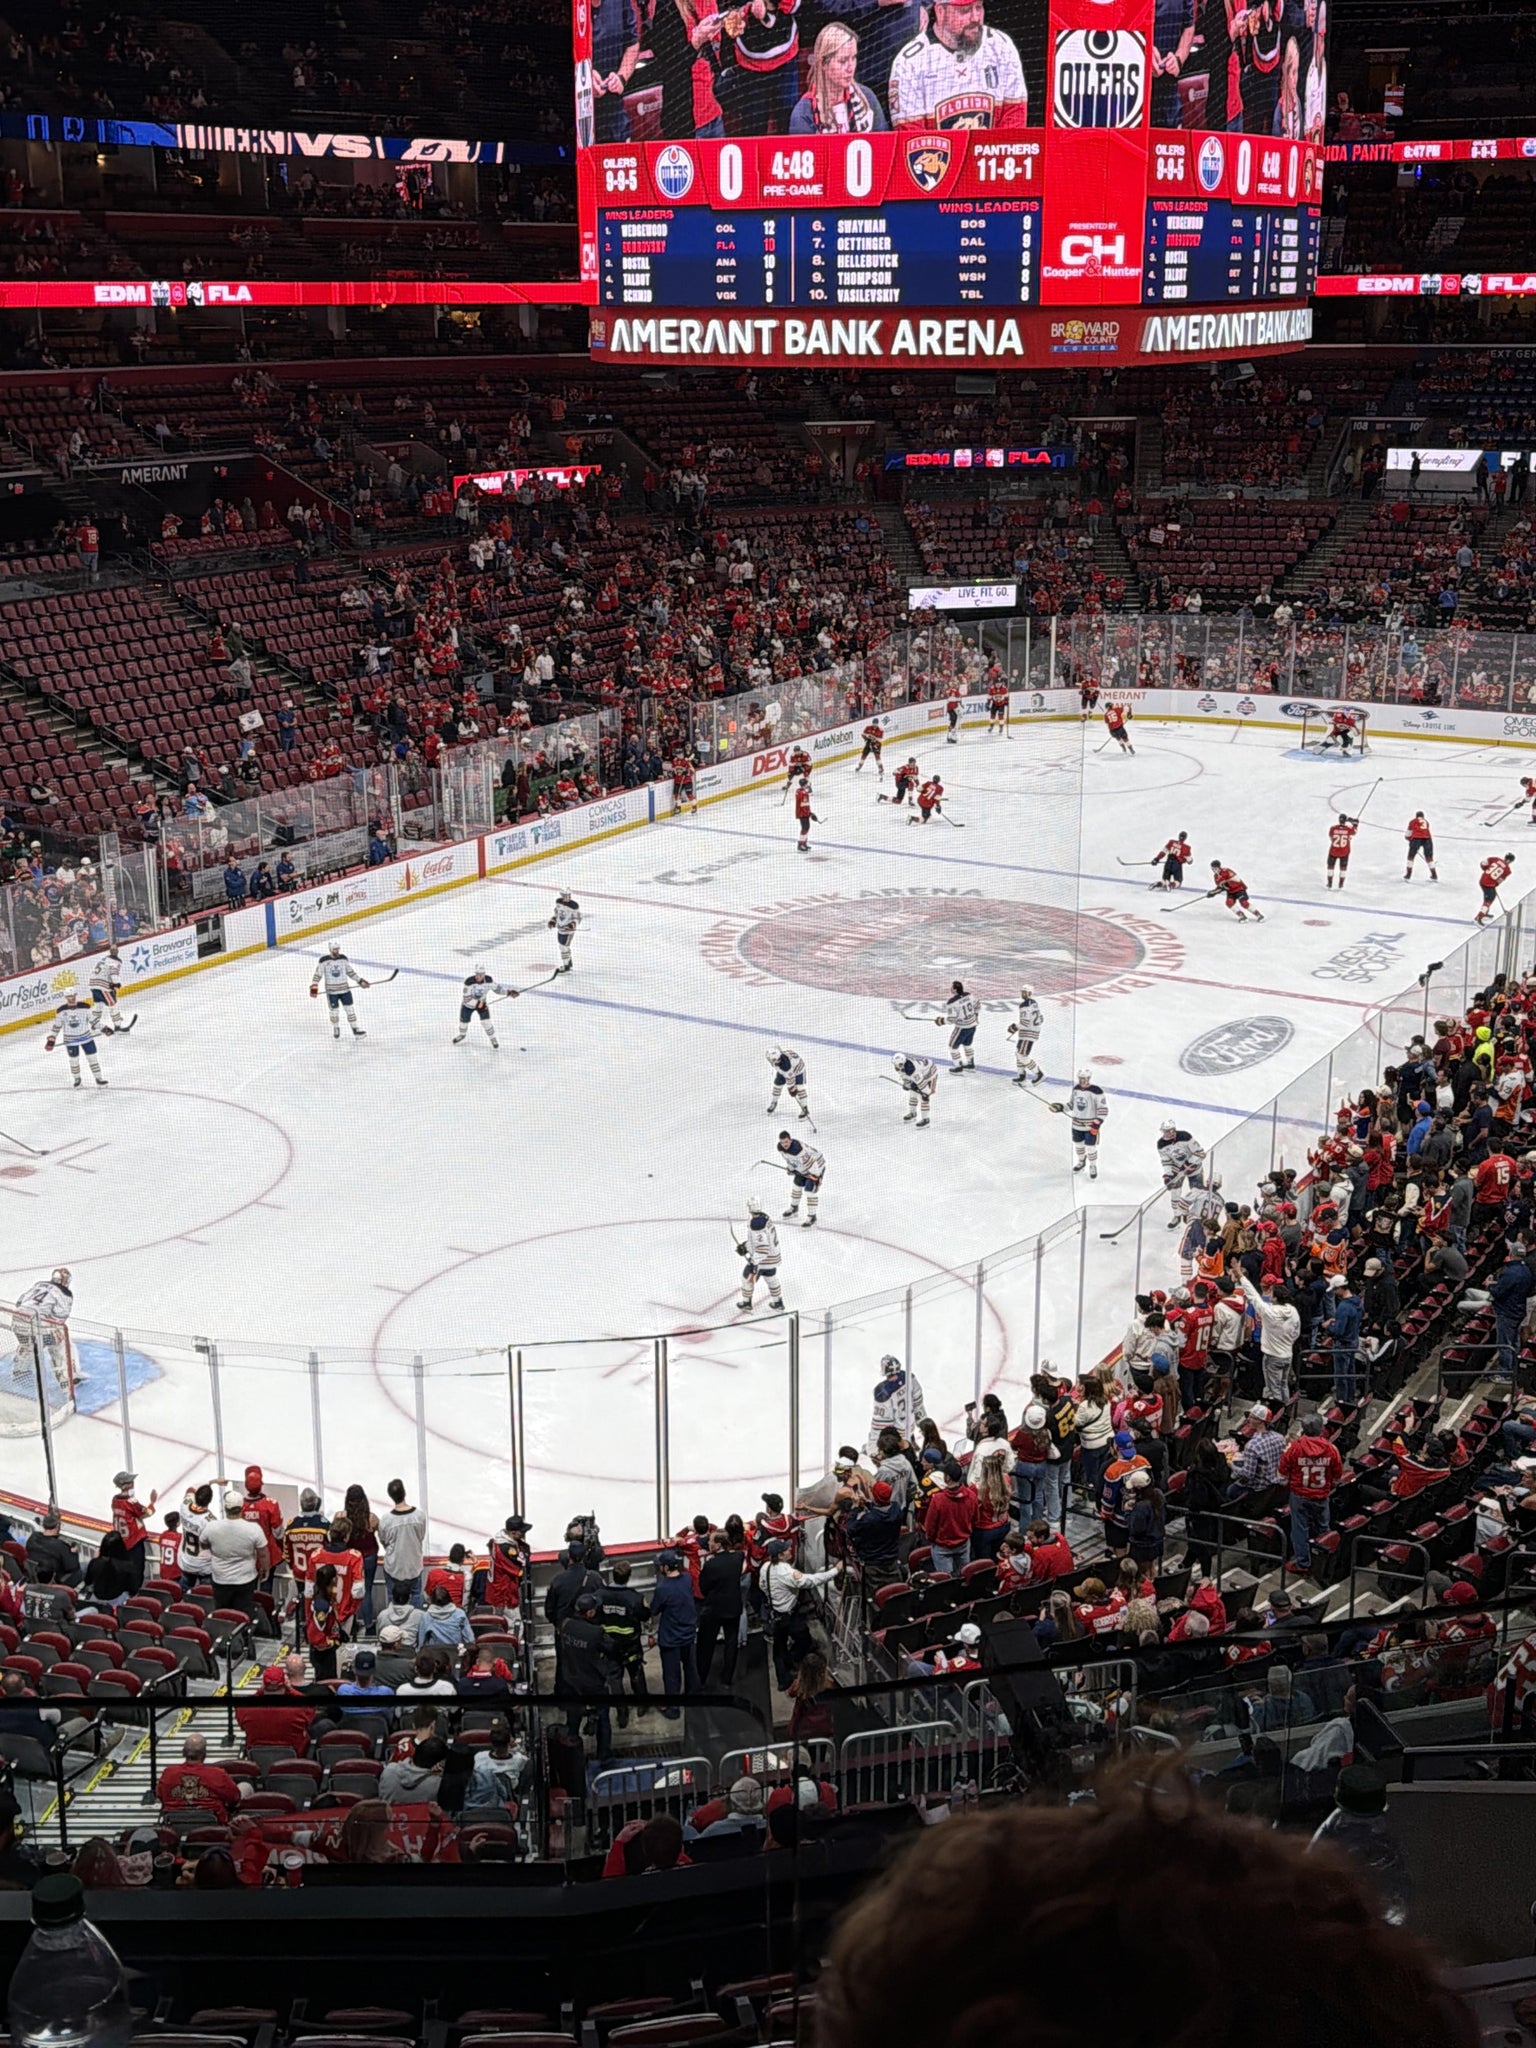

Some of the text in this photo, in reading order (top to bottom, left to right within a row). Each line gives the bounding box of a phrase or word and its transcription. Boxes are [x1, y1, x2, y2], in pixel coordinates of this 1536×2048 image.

[1060, 63, 1141, 95] OILERS
[294, 132, 373, 158] VS
[974, 143, 1040, 156] PANTHERS
[1156, 144, 1185, 156] OILERS
[603, 157, 637, 169] OILERS
[772, 151, 814, 180] 4:48
[846, 139, 872, 197] 0
[977, 158, 1032, 181] 11-8-1
[1237, 140, 1251, 195] 0
[1287, 145, 1298, 198] 0
[719, 144, 743, 200] 0
[606, 170, 637, 192] 9-9-5
[763, 184, 823, 196] PRE-GAME
[629, 209, 674, 220] LEADERS
[939, 201, 1039, 213] WINS LEADERS
[621, 224, 668, 237] WEDGEWOOD
[716, 224, 735, 233] COL
[763, 220, 775, 235] 12
[812, 221, 825, 231] 6.
[837, 219, 886, 233] SWAYMAN
[960, 220, 986, 229] BOS
[716, 242, 735, 250] FLA
[763, 238, 775, 253] 10
[812, 238, 825, 249] 7.
[837, 237, 891, 250] OETTINGER
[960, 237, 986, 246] DAL
[1061, 235, 1125, 265] CH
[716, 258, 736, 267] ANA
[763, 254, 775, 269] 10
[812, 255, 825, 266] 8.
[837, 254, 899, 268] HELLEBUYCK
[959, 255, 987, 264] WPG
[1043, 256, 1141, 280] Cooper & Hunter
[623, 273, 650, 286] TALBOT
[716, 275, 735, 284] DET
[765, 271, 773, 286] 9
[812, 272, 825, 283] 9.
[837, 272, 892, 285] THOMPSON
[959, 272, 986, 281] WSH
[1357, 276, 1534, 292] EDM FLA
[94, 285, 252, 302] EDM FLA
[716, 291, 736, 300] VGK
[809, 289, 827, 300] 10.
[837, 288, 900, 303] VASILEVSKIY
[960, 290, 984, 299] TBL
[610, 318, 1024, 355] AMERANT BANK ARENA
[1140, 310, 1291, 352] AMERANT BANK
[1084, 336, 1117, 344] COUNTY
[1353, 421, 1369, 430] 108
[906, 451, 1051, 465] EDM FLA
[121, 465, 188, 485] AMERANT
[958, 587, 1009, 598] LIVE. FIT. GO.
[1402, 720, 1420, 730] Disney
[1422, 722, 1441, 730] CRUISE
[814, 731, 854, 750] AutoNation
[752, 747, 791, 777] DEX
[589, 798, 626, 818] COMCAST
[589, 811, 627, 831] BUSINESS
[1420, 818, 1428, 830] 3
[1332, 834, 1348, 848] 26
[423, 855, 454, 879] Coca-Cola
[1486, 863, 1504, 880] 38
[751, 887, 984, 915] BANK ARENA
[152, 934, 193, 956] Broward
[1080, 906, 1187, 972] AMERANT
[153, 954, 183, 970] Pediatric
[1311, 945, 1377, 979] OMEGA
[1341, 949, 1406, 984] SPORT
[21, 1001, 34, 1010] ICED
[962, 1002, 974, 1020] 19
[1198, 1017, 1279, 1065] Ford
[1497, 1168, 1510, 1185] 15
[1197, 1326, 1211, 1351] 19
[1301, 1466, 1327, 1488] 13
[289, 1533, 324, 1542] MARCHAND
[161, 1547, 174, 1565] 19
